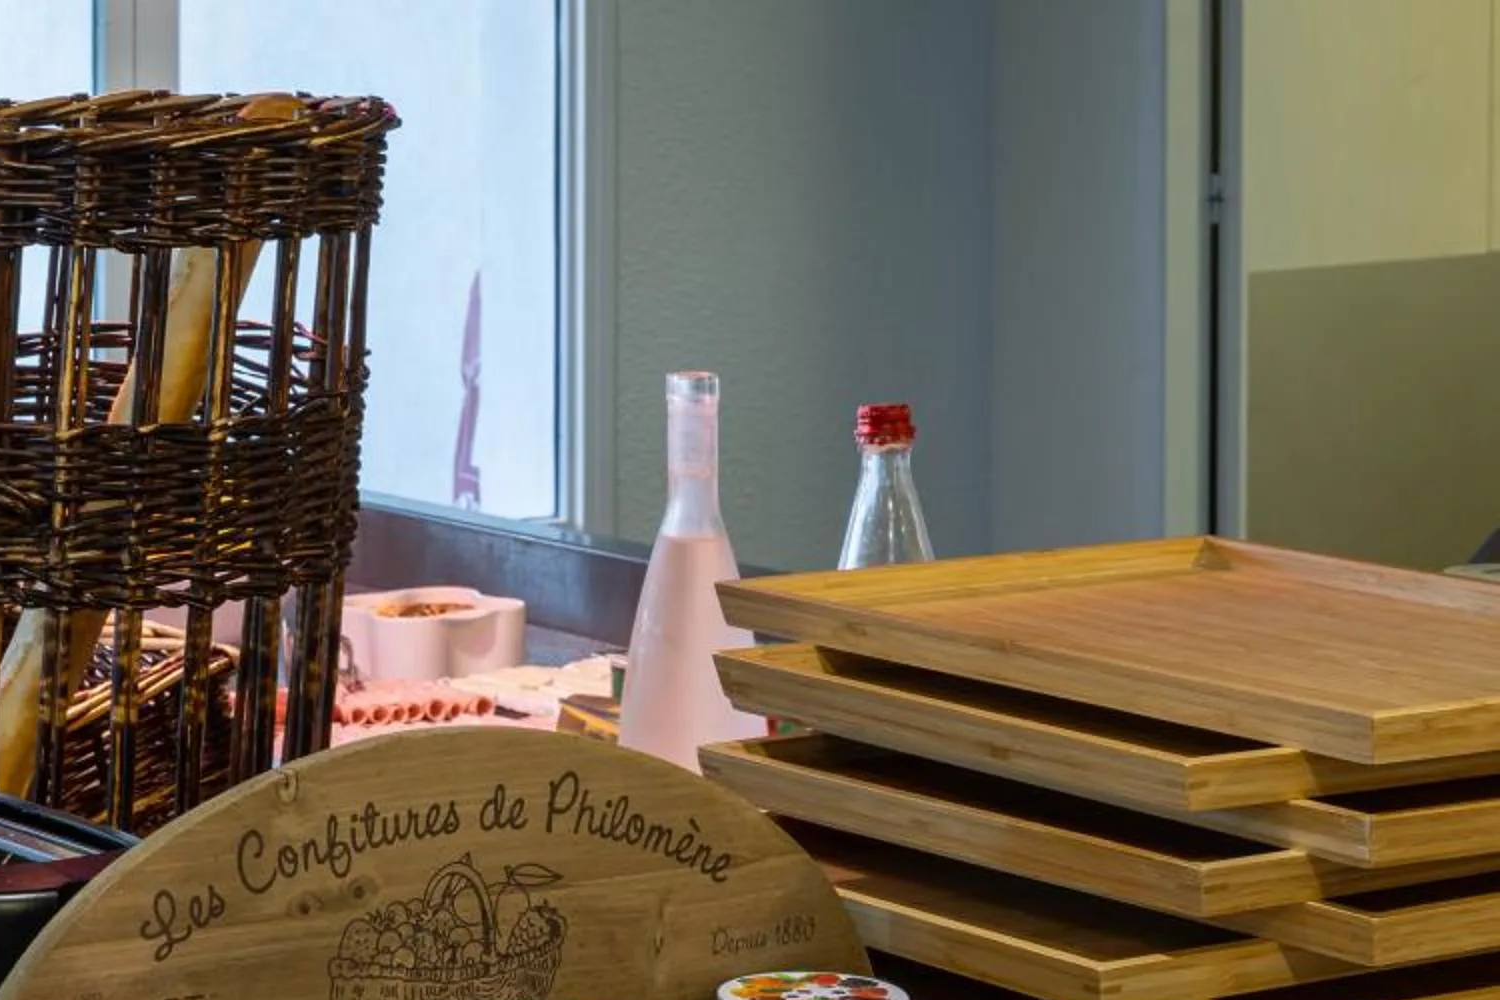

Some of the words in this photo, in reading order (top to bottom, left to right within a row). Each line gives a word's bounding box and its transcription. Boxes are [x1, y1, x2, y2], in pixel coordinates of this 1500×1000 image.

[140, 885, 226, 962] Les
[237, 800, 461, 895] Confitures
[479, 783, 529, 832] de
[545, 770, 732, 884] Philomène
